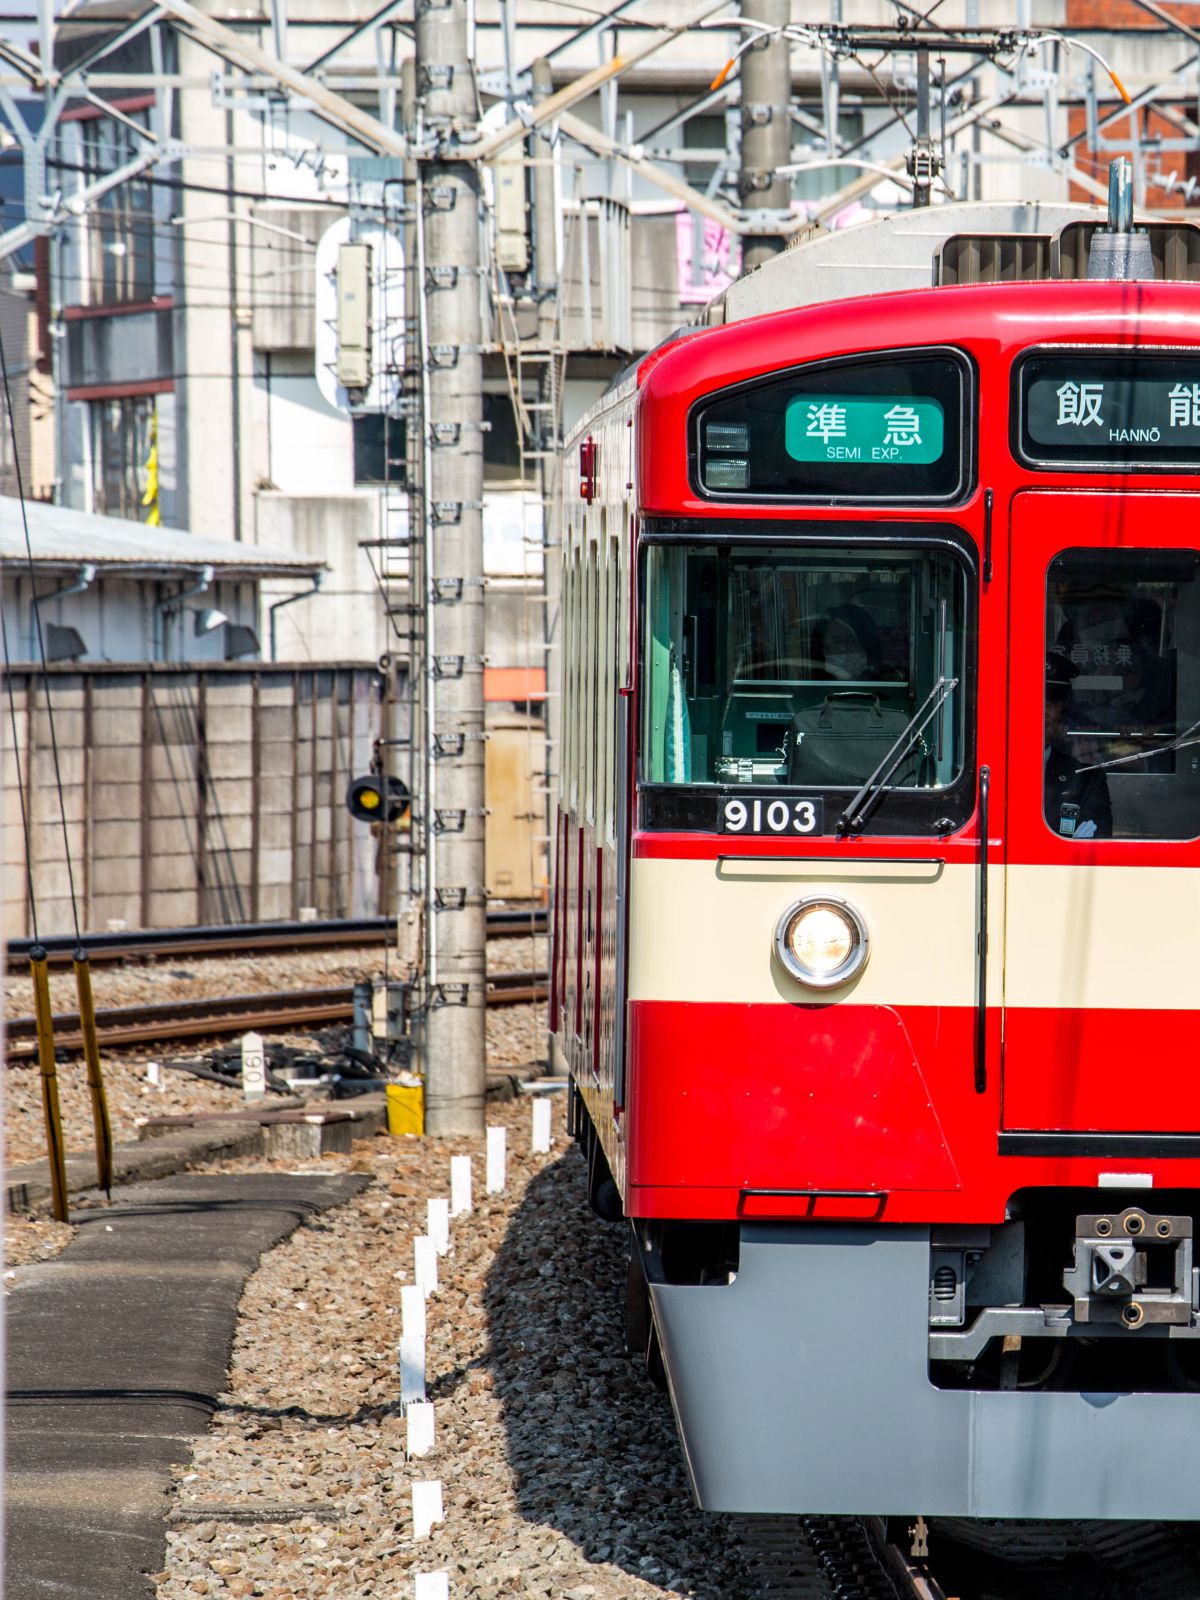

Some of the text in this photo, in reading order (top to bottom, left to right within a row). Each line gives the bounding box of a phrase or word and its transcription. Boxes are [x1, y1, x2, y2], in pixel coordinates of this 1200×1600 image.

[805, 403, 923, 446] 準急
[826, 447, 903, 460] SEMI EXP.
[724, 800, 816, 832] 9103
